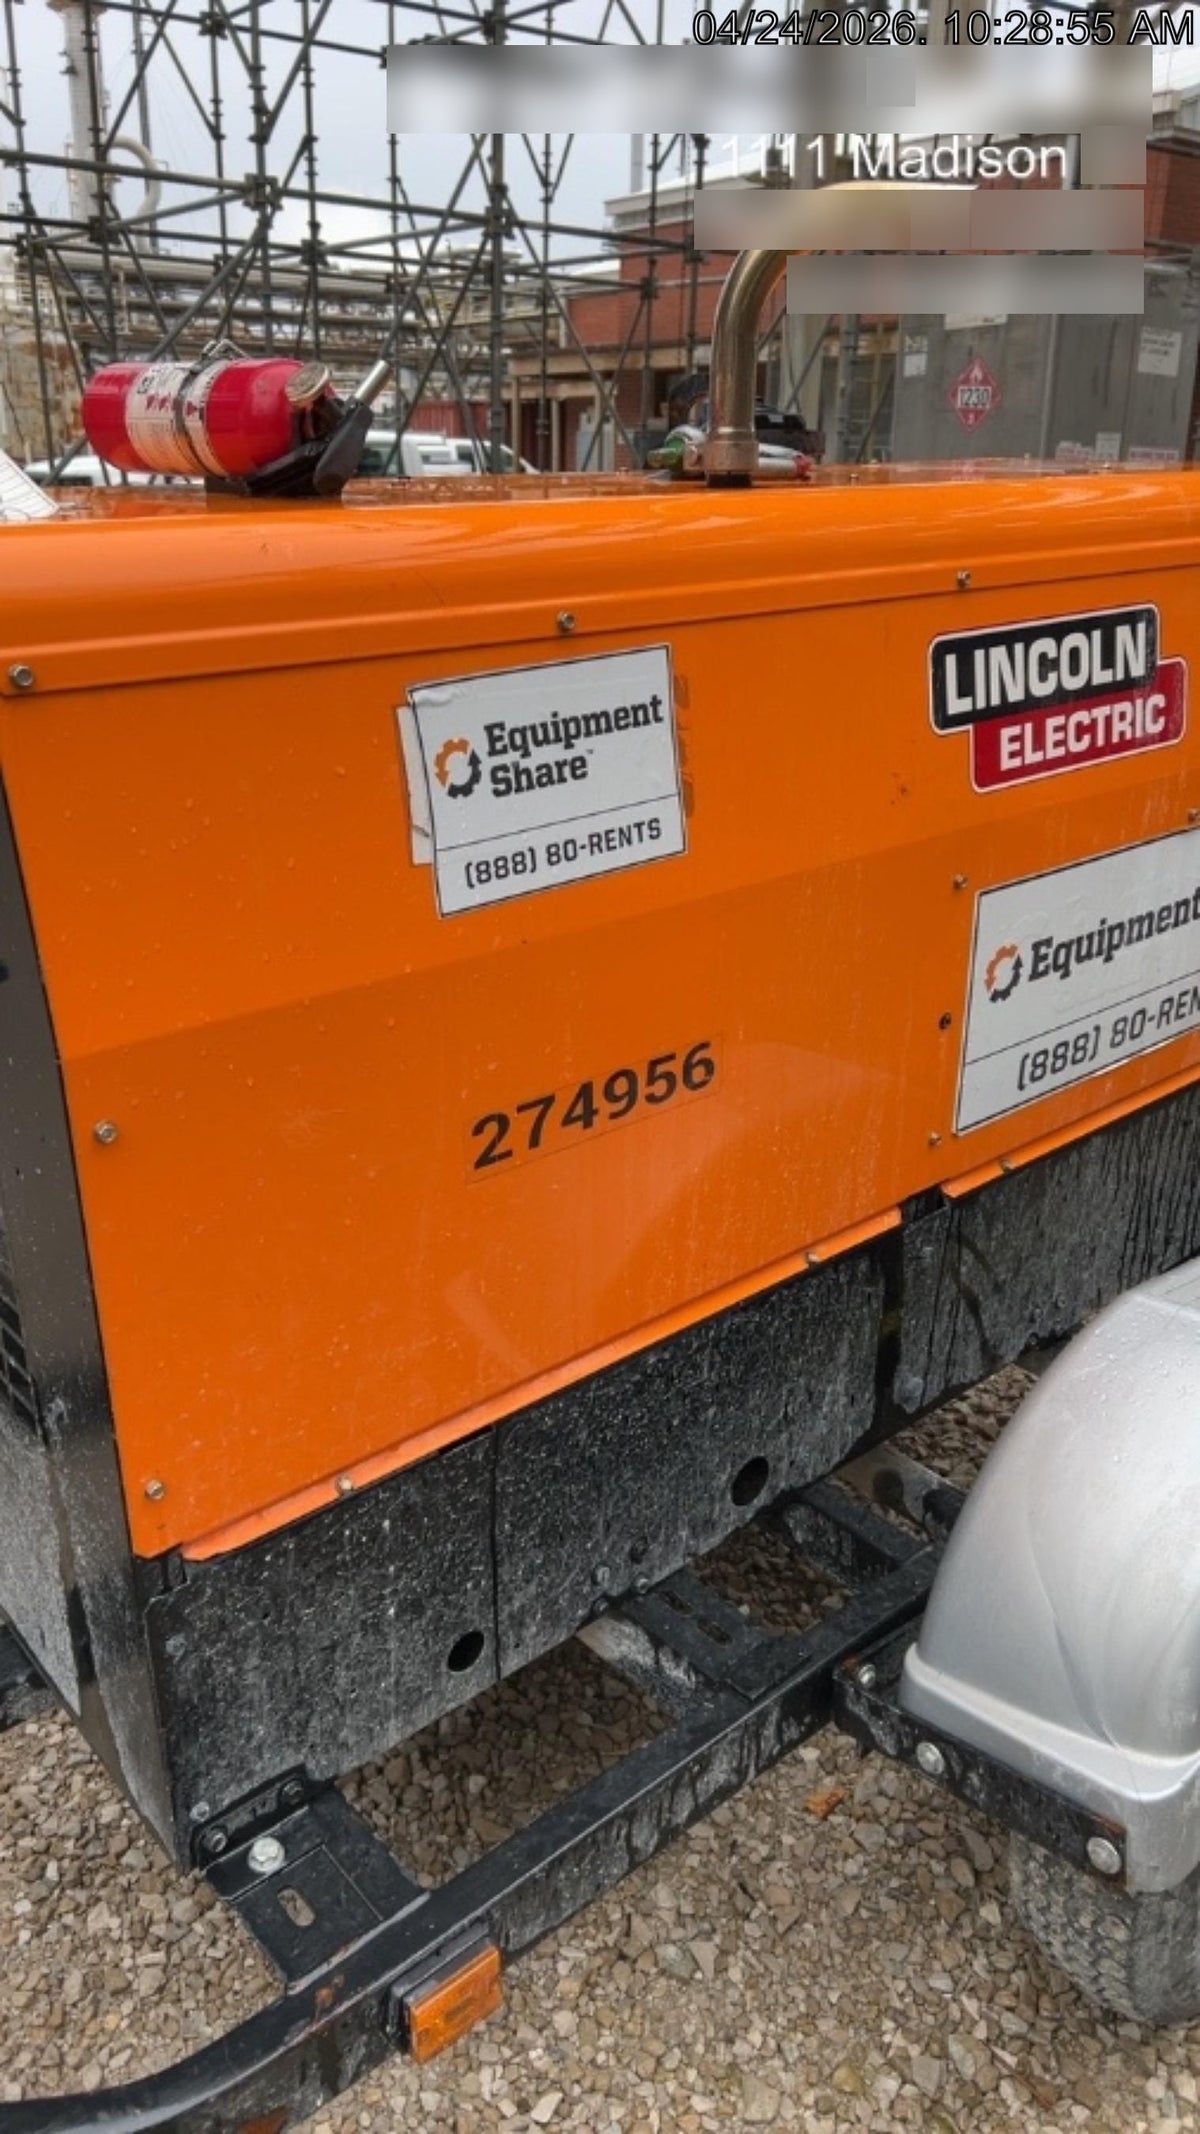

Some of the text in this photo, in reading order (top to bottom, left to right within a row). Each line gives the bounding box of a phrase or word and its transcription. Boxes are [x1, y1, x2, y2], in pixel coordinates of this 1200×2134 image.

[960, 387, 991, 407] 1230
[945, 620, 1147, 716] LINCOLN
[483, 694, 664, 760] Equipment
[1000, 694, 1166, 771] ELECTRIC
[464, 817, 662, 889] (888) 80-RENTS
[1017, 1025, 1101, 1091] (888)
[471, 1041, 715, 1170] 274956
